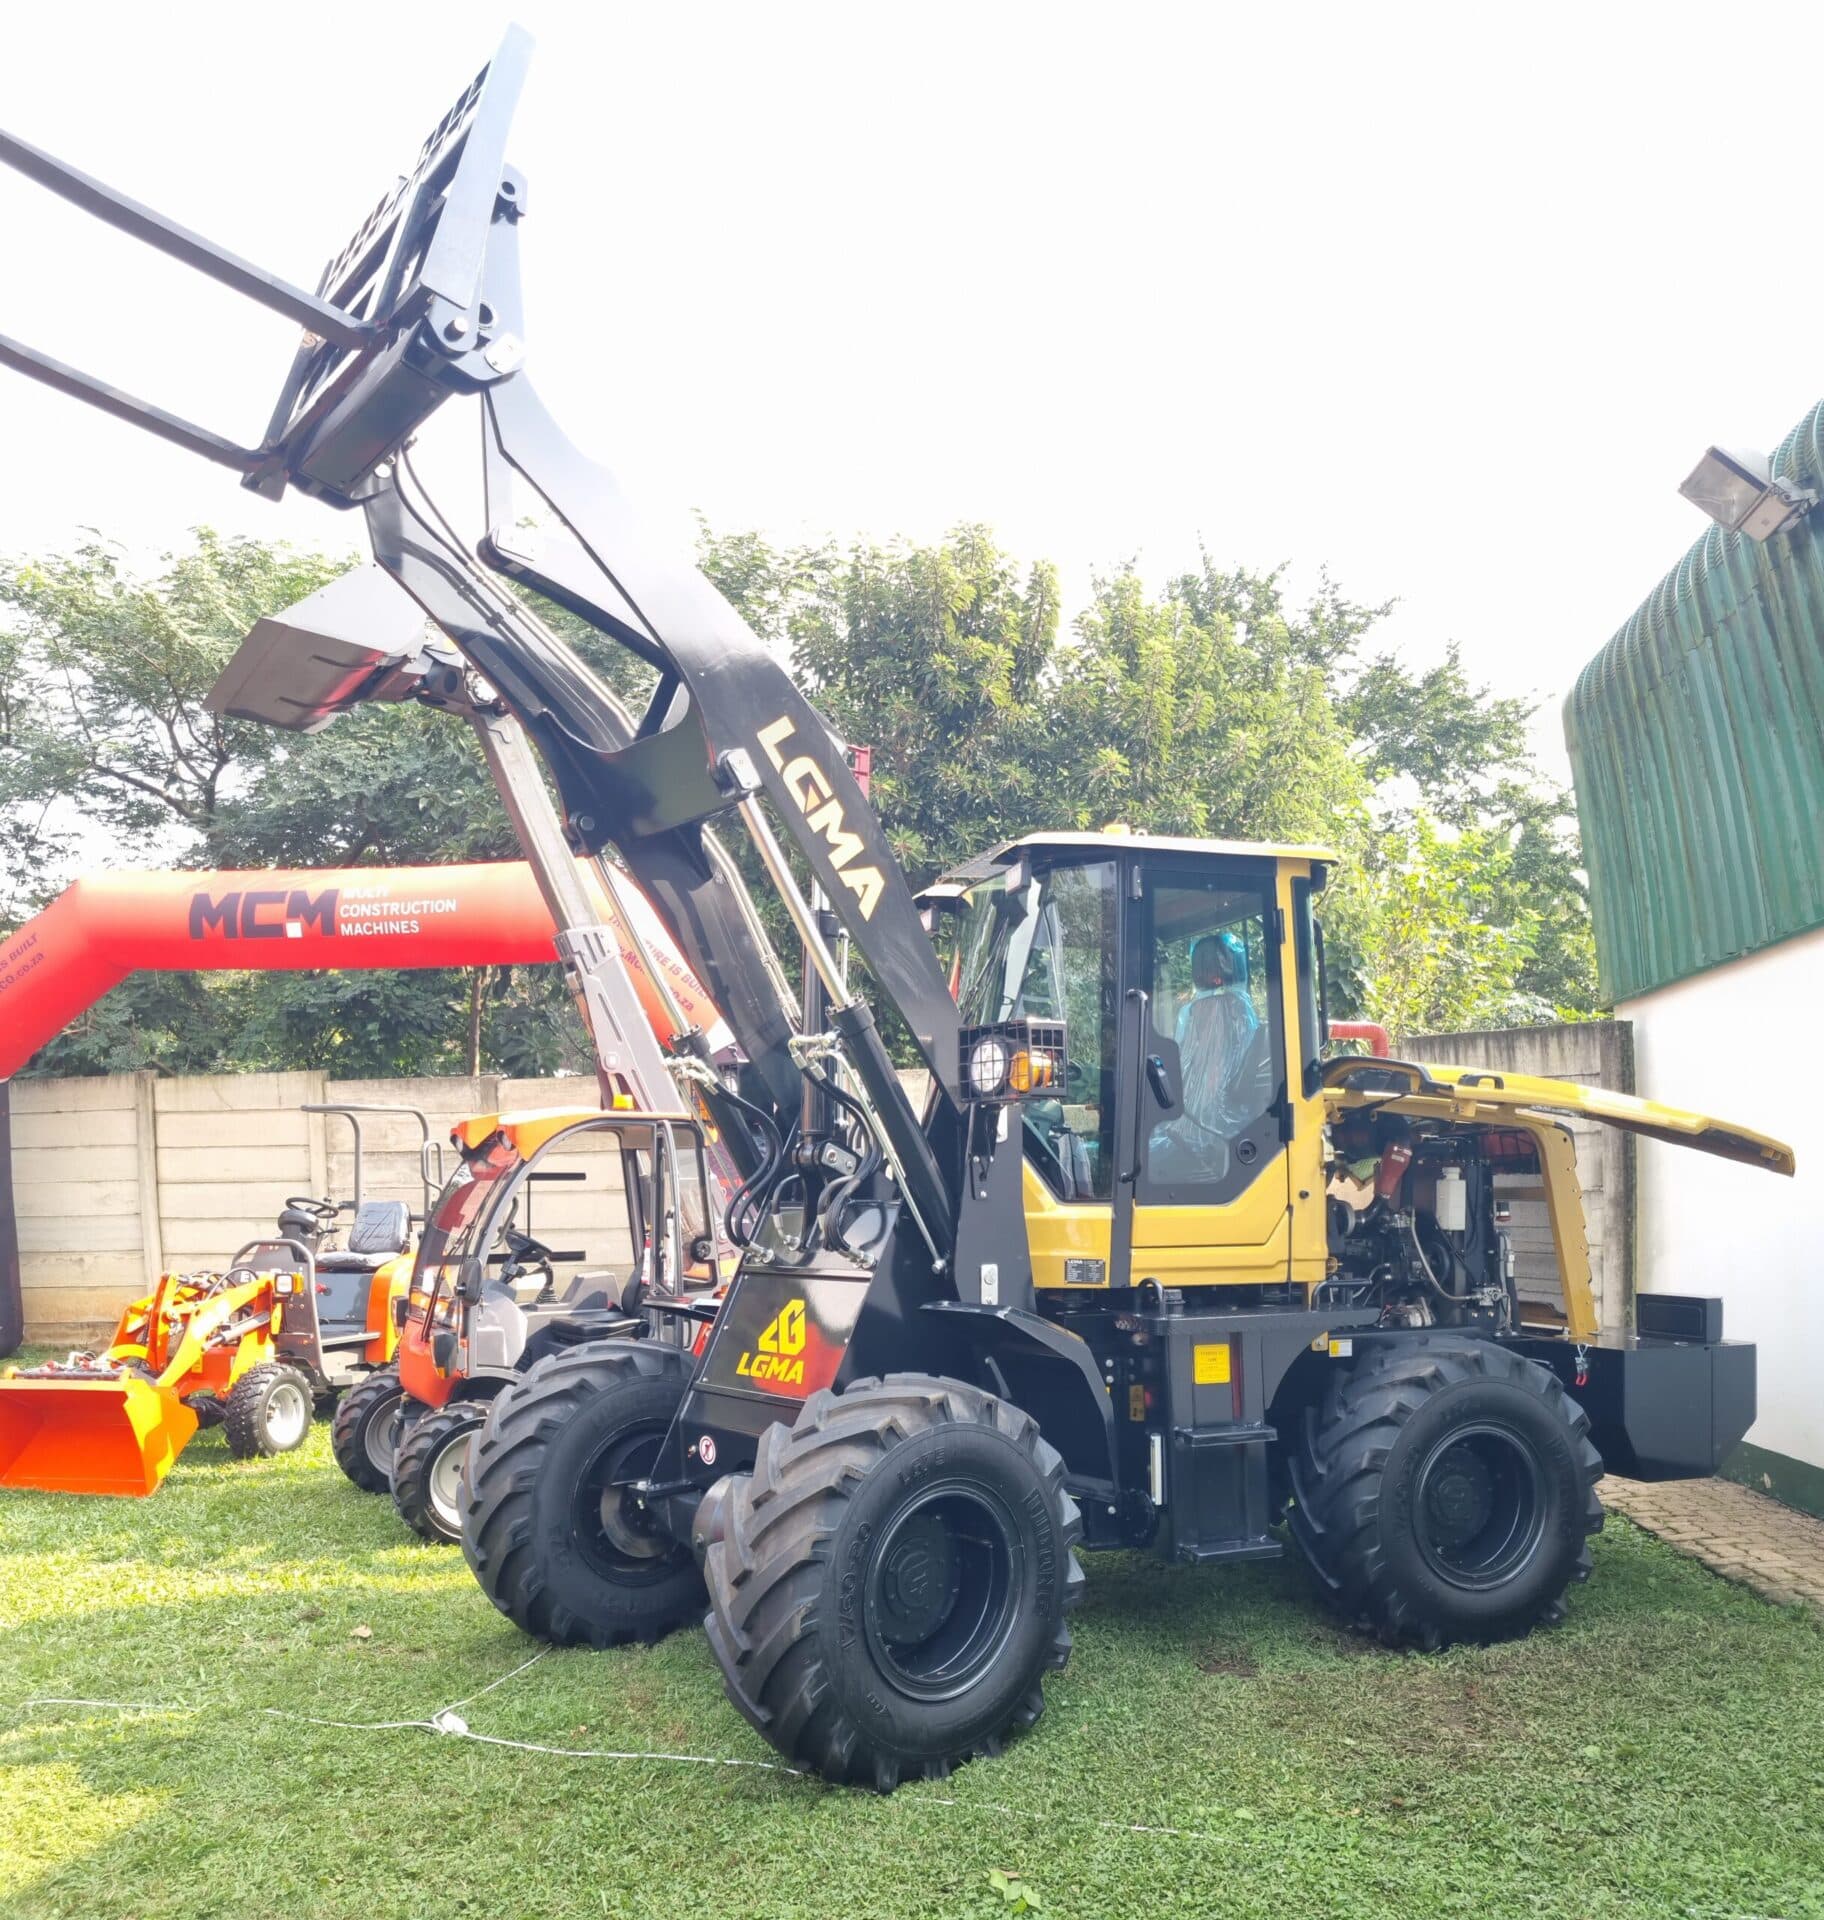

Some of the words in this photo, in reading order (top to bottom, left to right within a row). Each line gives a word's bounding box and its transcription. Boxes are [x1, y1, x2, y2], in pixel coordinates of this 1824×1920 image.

[756, 715, 885, 922] LGMA
[189, 889, 339, 938] MCM
[340, 898, 457, 918] CONSTRUCTION
[340, 920, 419, 936] MACHINES
[9, 932, 38, 961] BUILT
[0, 953, 44, 991] CO.co.za
[669, 963, 682, 976] IS
[736, 1352, 804, 1384] LGMA
